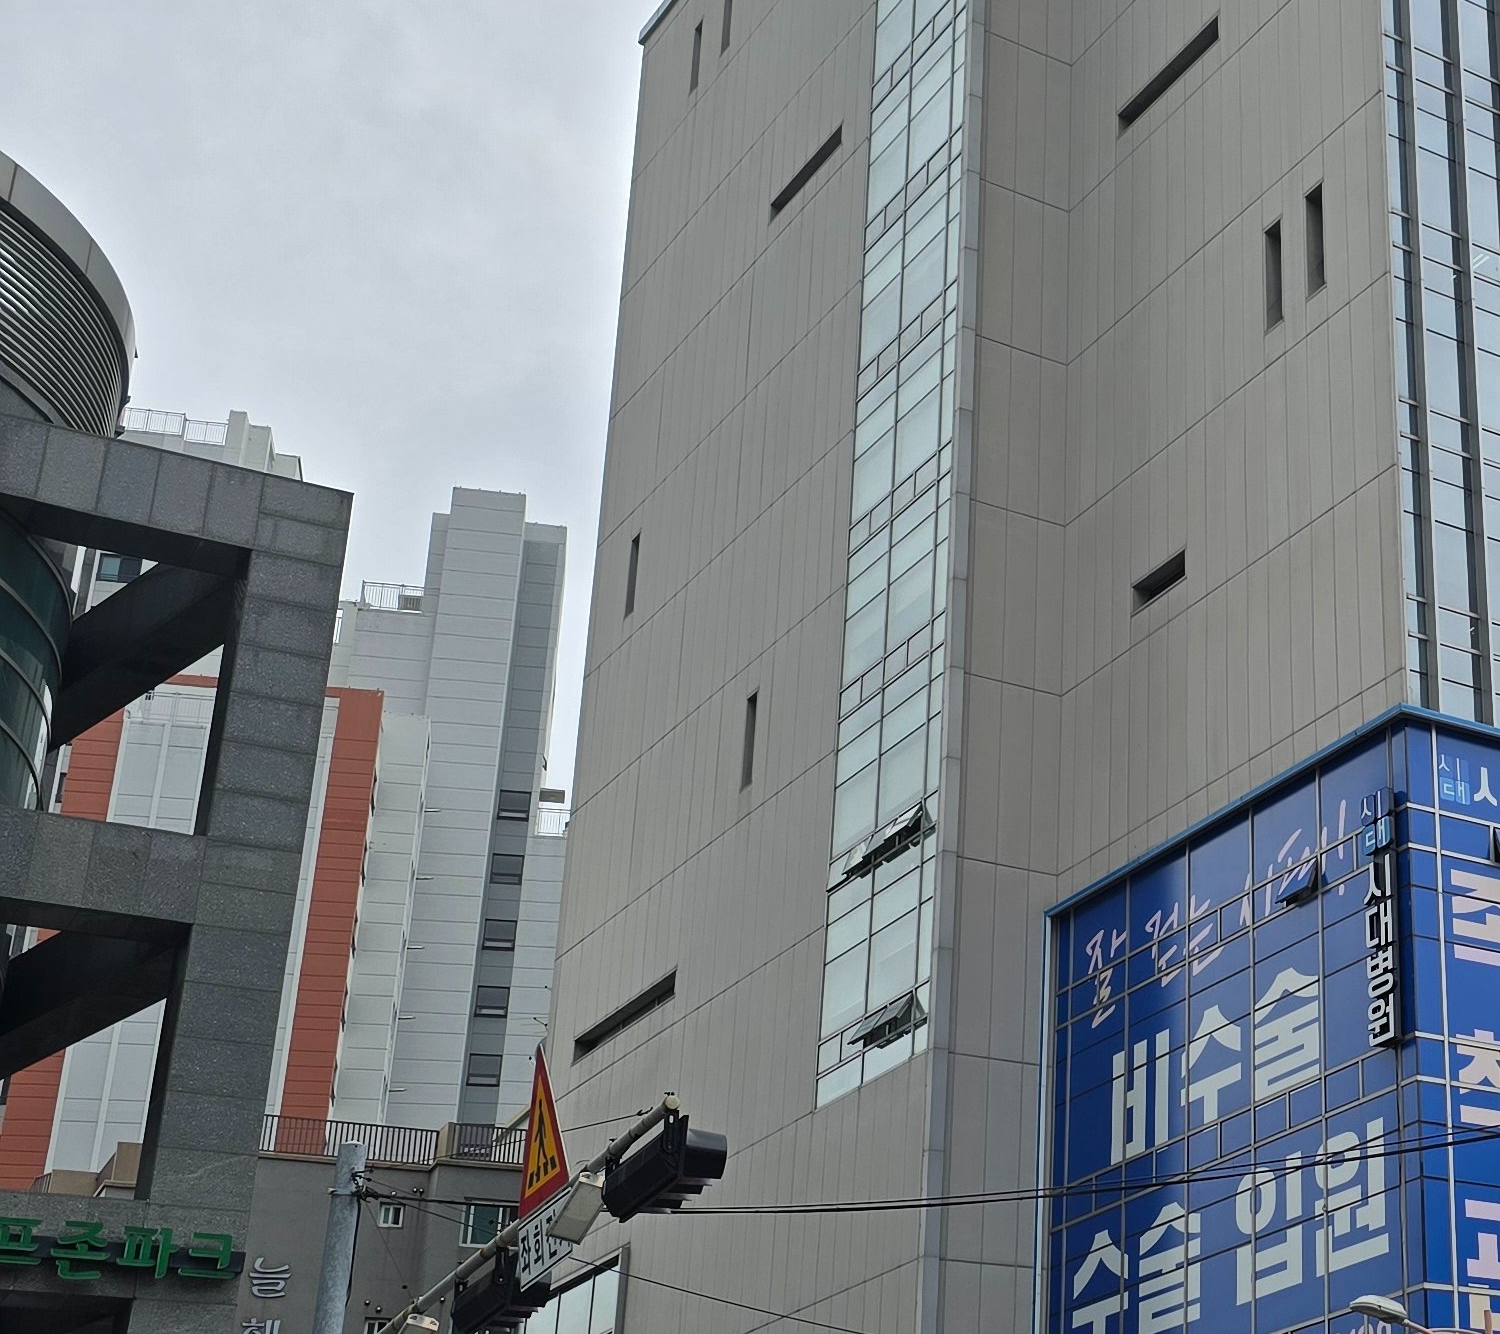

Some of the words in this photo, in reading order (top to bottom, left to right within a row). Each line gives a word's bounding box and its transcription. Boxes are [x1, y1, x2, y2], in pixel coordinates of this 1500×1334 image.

[1085, 928, 1127, 1029] 잘
[1363, 853, 1396, 1048] 시대병원
[1109, 966, 1320, 1167] 비수술
[1234, 1116, 1390, 1309] 입원
